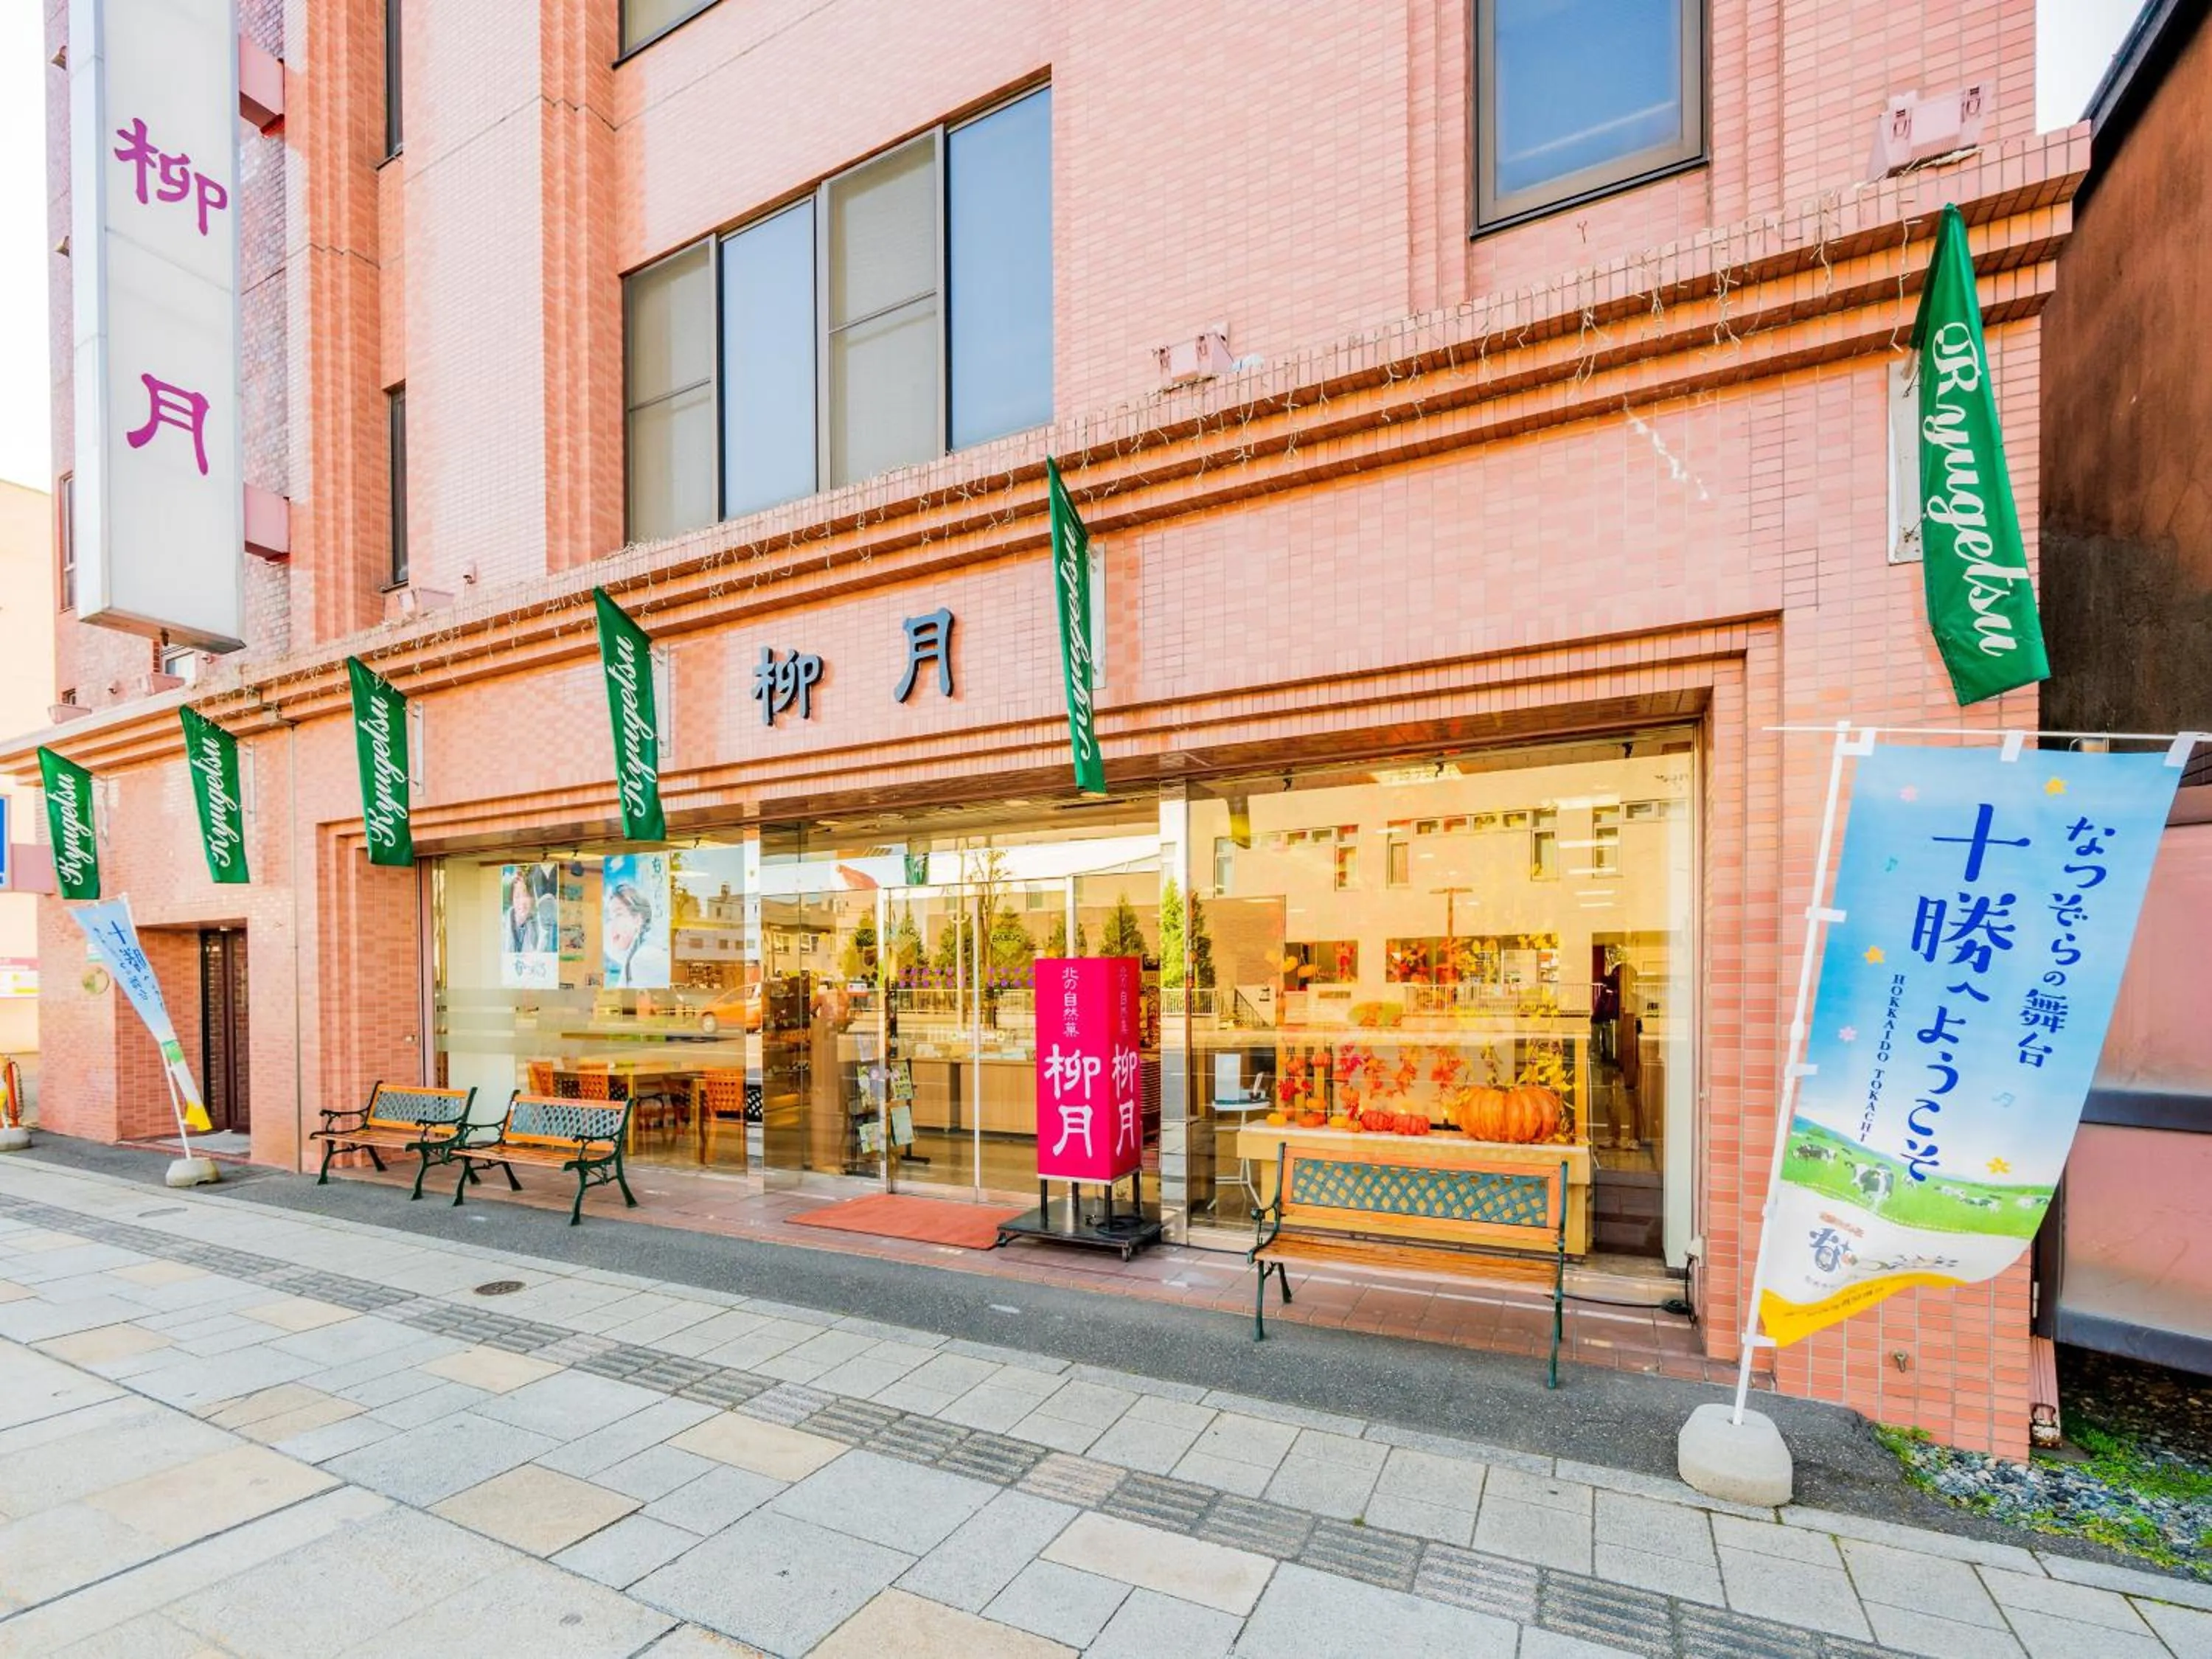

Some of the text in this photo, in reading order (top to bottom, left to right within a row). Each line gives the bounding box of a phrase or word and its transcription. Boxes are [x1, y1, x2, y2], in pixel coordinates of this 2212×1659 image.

[114, 117, 228, 476] 柳月
[1923, 322, 2030, 657] Ryugetsu
[751, 607, 954, 726] 柳月
[1062, 967, 1079, 1037] 北の自然菓
[1899, 803, 2031, 1182] 十勝へようこそ
[2017, 816, 2115, 1068] なつぞらの舞台
[1044, 1043, 1101, 1158] 柳月
[1112, 1043, 1138, 1156] 柳月
[1860, 974, 1906, 1142] HOKKAIDO TOKACHI
